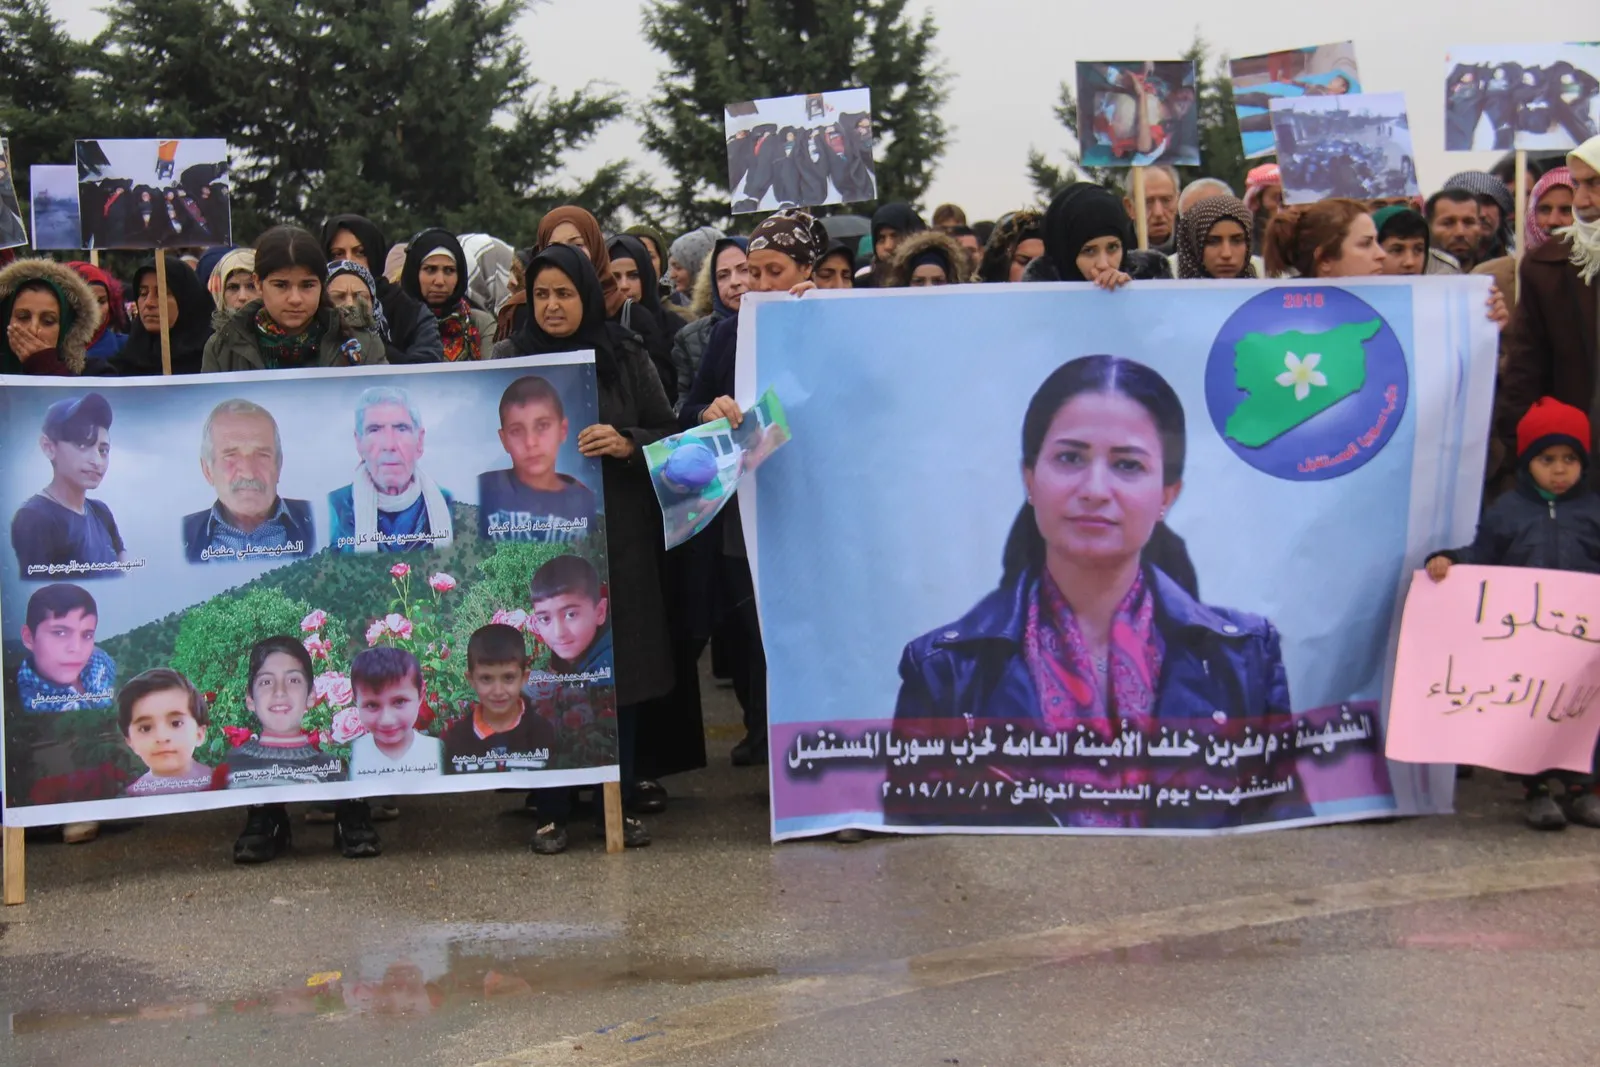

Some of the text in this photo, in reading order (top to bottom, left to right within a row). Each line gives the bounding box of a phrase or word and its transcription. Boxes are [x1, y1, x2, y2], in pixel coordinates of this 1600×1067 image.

[1283, 293, 1324, 309] 2018
[420, 529, 449, 543] الشهيد
[553, 517, 588, 533] الشهيد
[200, 540, 303, 560] الشهيد علي عثمان
[91, 562, 116, 572] محمد
[116, 558, 146, 572] الشهيد
[1475, 579, 1600, 644] قتلوا
[1426, 654, 1546, 719] الأبرياء
[1002, 723, 1068, 758] العامة
[1073, 718, 1142, 766] الأمينة
[1147, 726, 1200, 757] خلف
[1294, 704, 1371, 756] الشهيدة
[787, 729, 880, 769] المستقبل
[885, 730, 945, 766] سوريا
[950, 725, 997, 766] لحزب
[413, 762, 438, 774] الشهيد
[1010, 778, 1073, 805] الموافق
[1079, 783, 1150, 806] السبت
[1155, 785, 1190, 808] يوم
[1195, 775, 1293, 806] استشهدت
